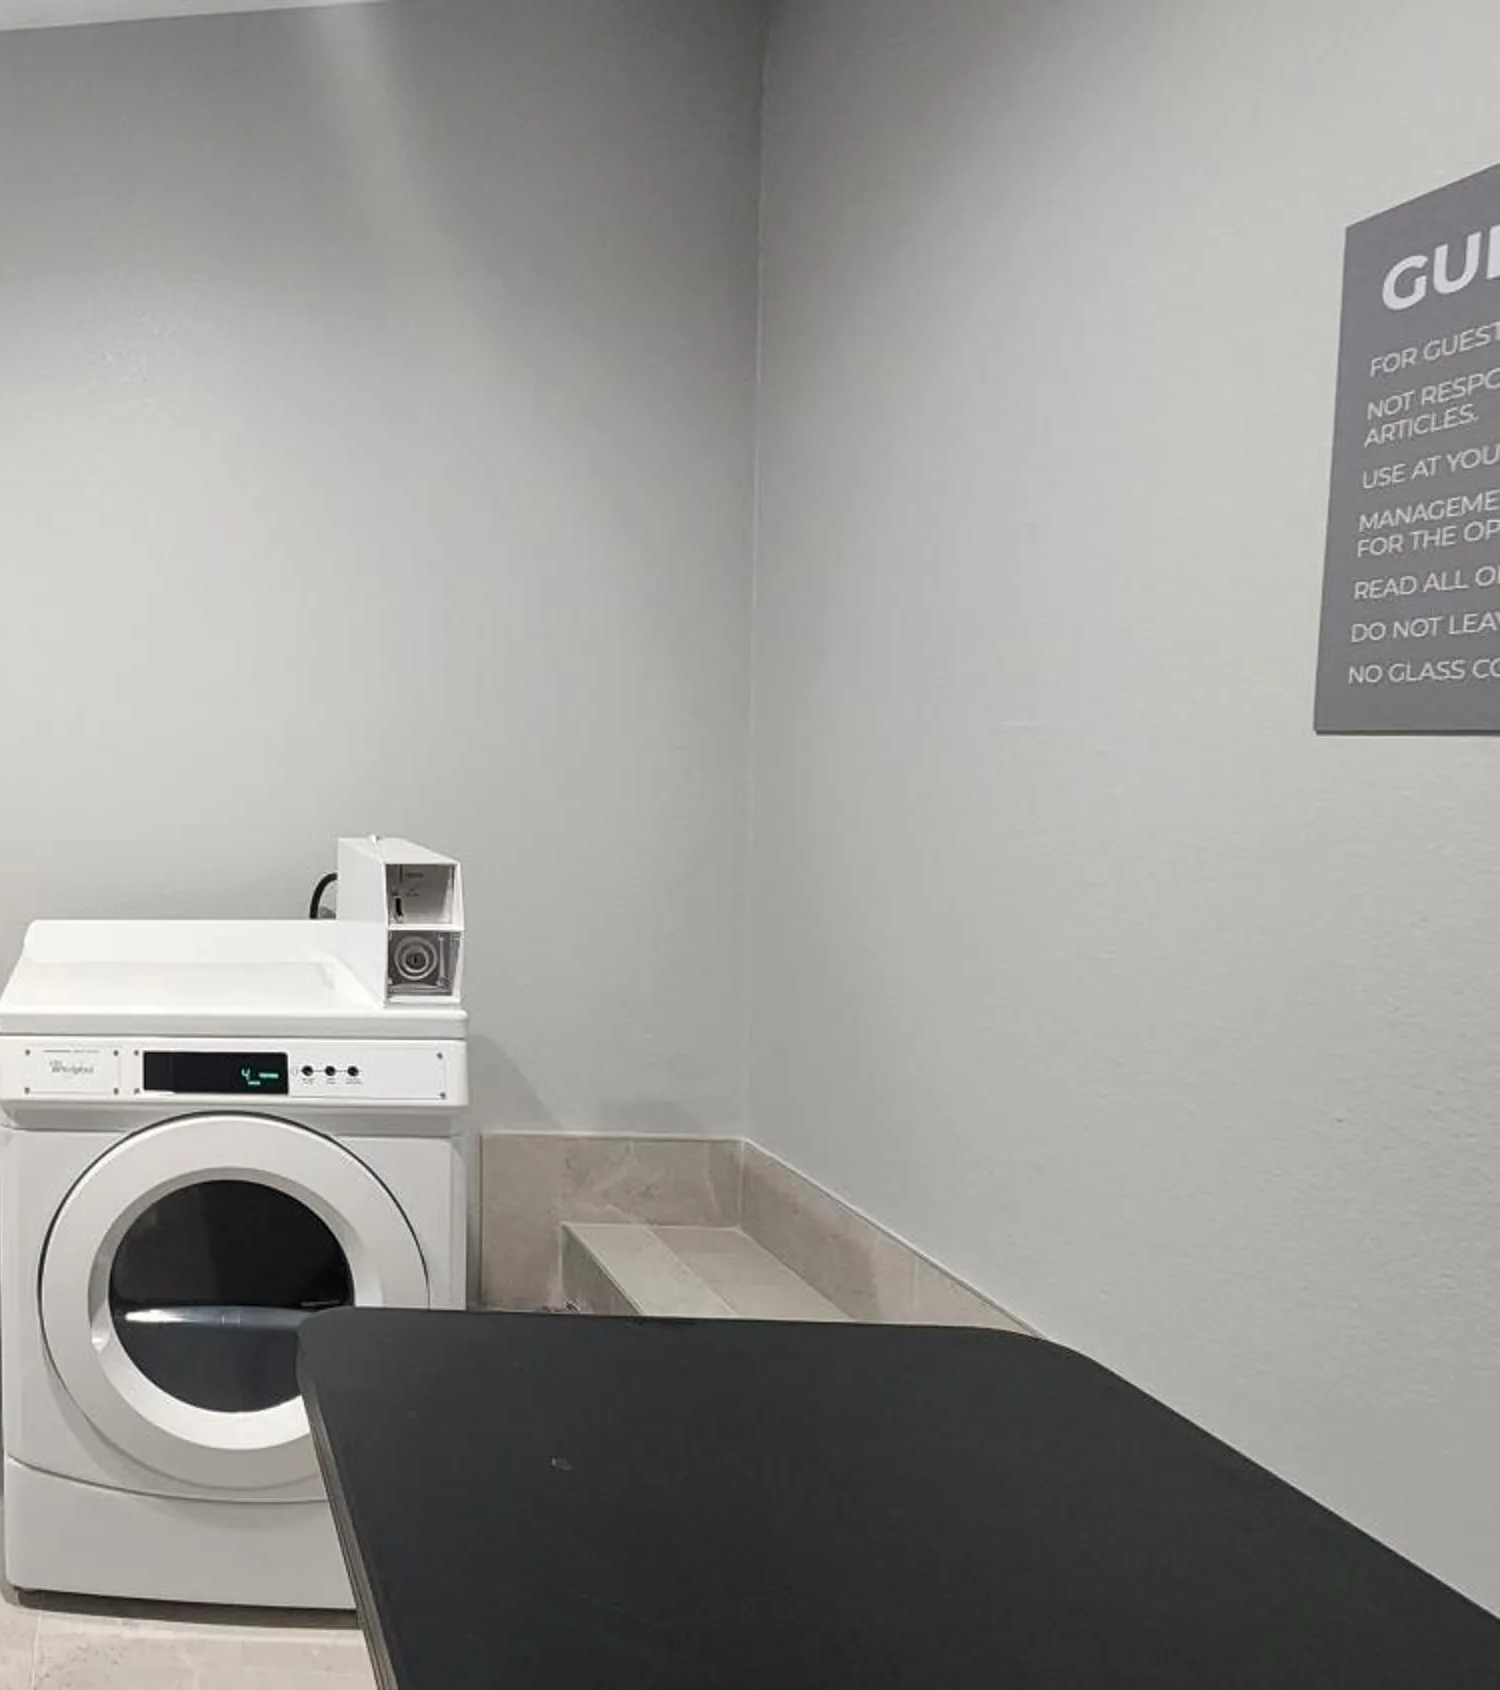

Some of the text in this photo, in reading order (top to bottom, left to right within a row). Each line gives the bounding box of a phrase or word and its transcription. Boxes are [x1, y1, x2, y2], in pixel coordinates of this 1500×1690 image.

[1369, 347, 1418, 378] FOR
[1367, 389, 1416, 421] NOT
[1363, 403, 1480, 448] ARTICLES.
[1362, 463, 1407, 489] USE
[1411, 455, 1442, 480] AT
[1357, 533, 1404, 558] FOR
[1410, 525, 1457, 550] THE
[1354, 565, 1500, 600] READ ALL O
[1351, 621, 1387, 643] DO
[1392, 615, 1444, 639] NOT
[1348, 664, 1383, 684] NO
[1388, 660, 1466, 682] GLASS
